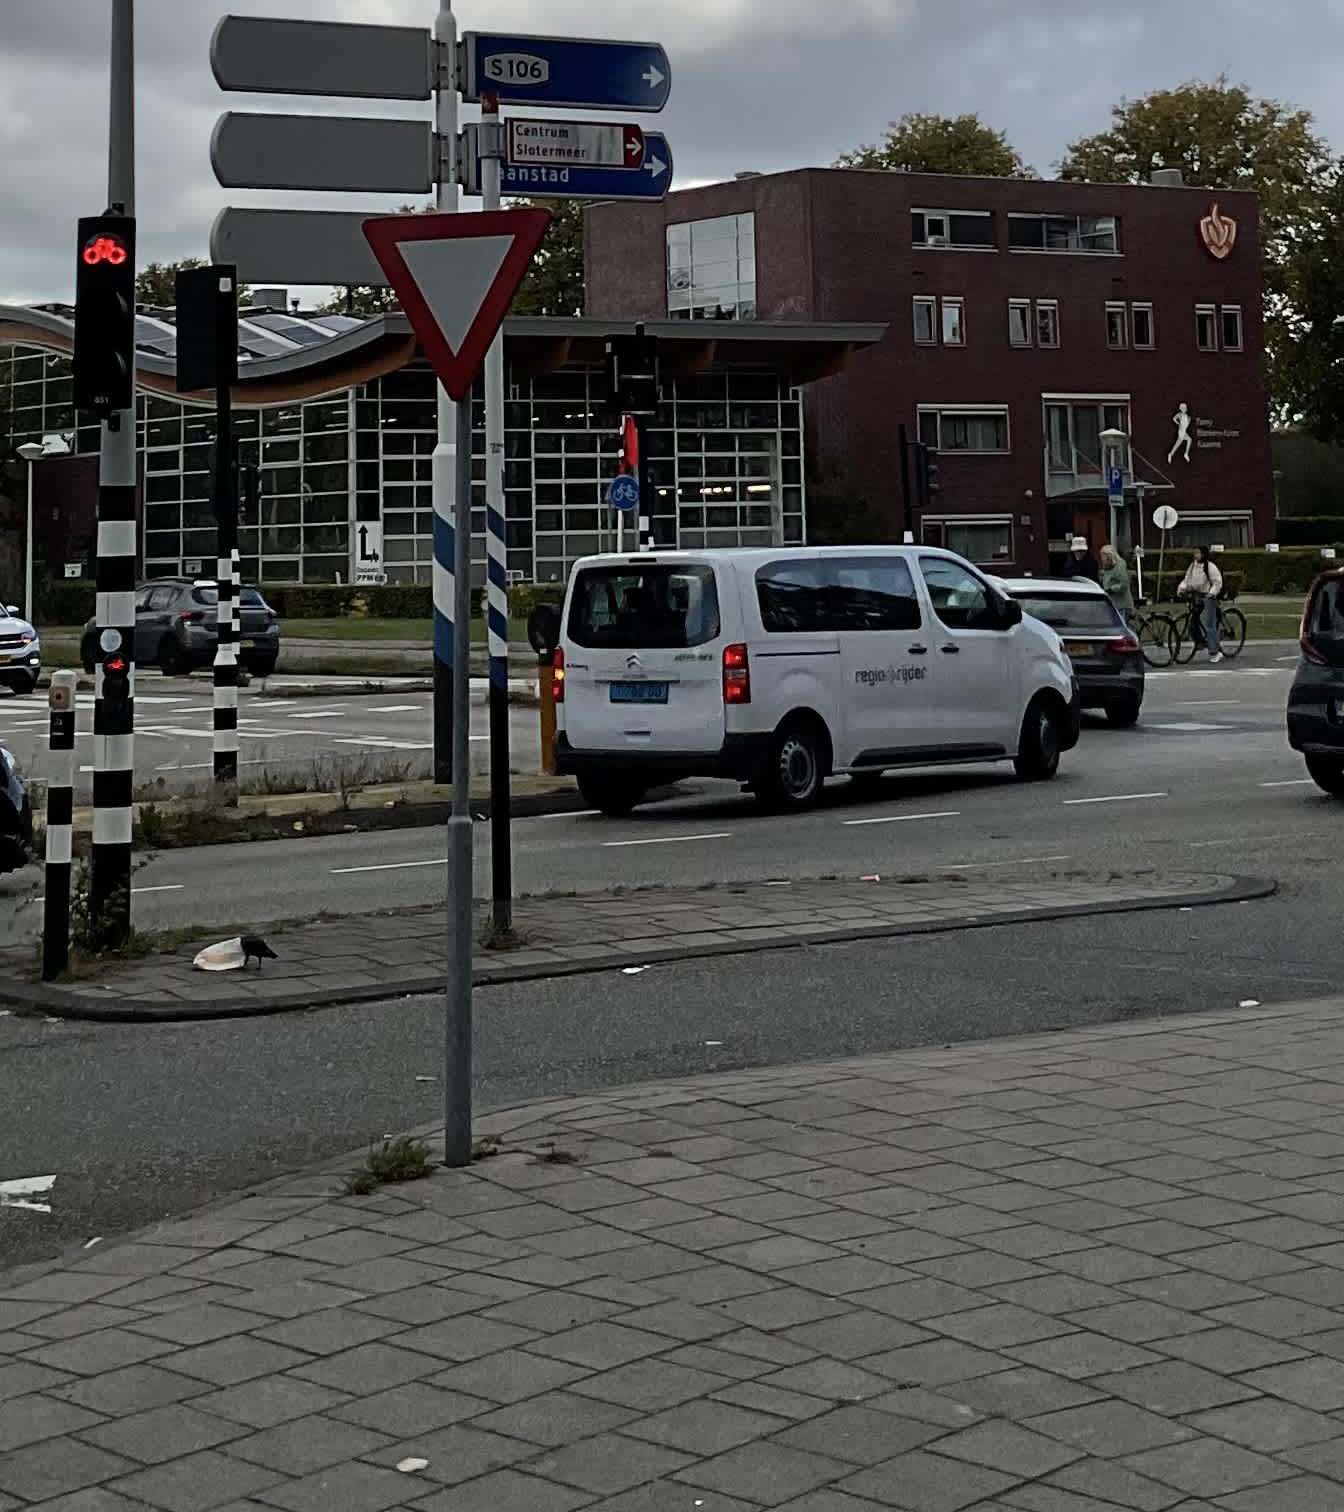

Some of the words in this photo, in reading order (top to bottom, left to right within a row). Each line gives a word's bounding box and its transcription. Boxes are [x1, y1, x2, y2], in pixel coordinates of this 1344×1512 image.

[516, 124, 569, 139] Centrum
[516, 143, 586, 159] Slotermeer
[1111, 469, 1121, 484] P
